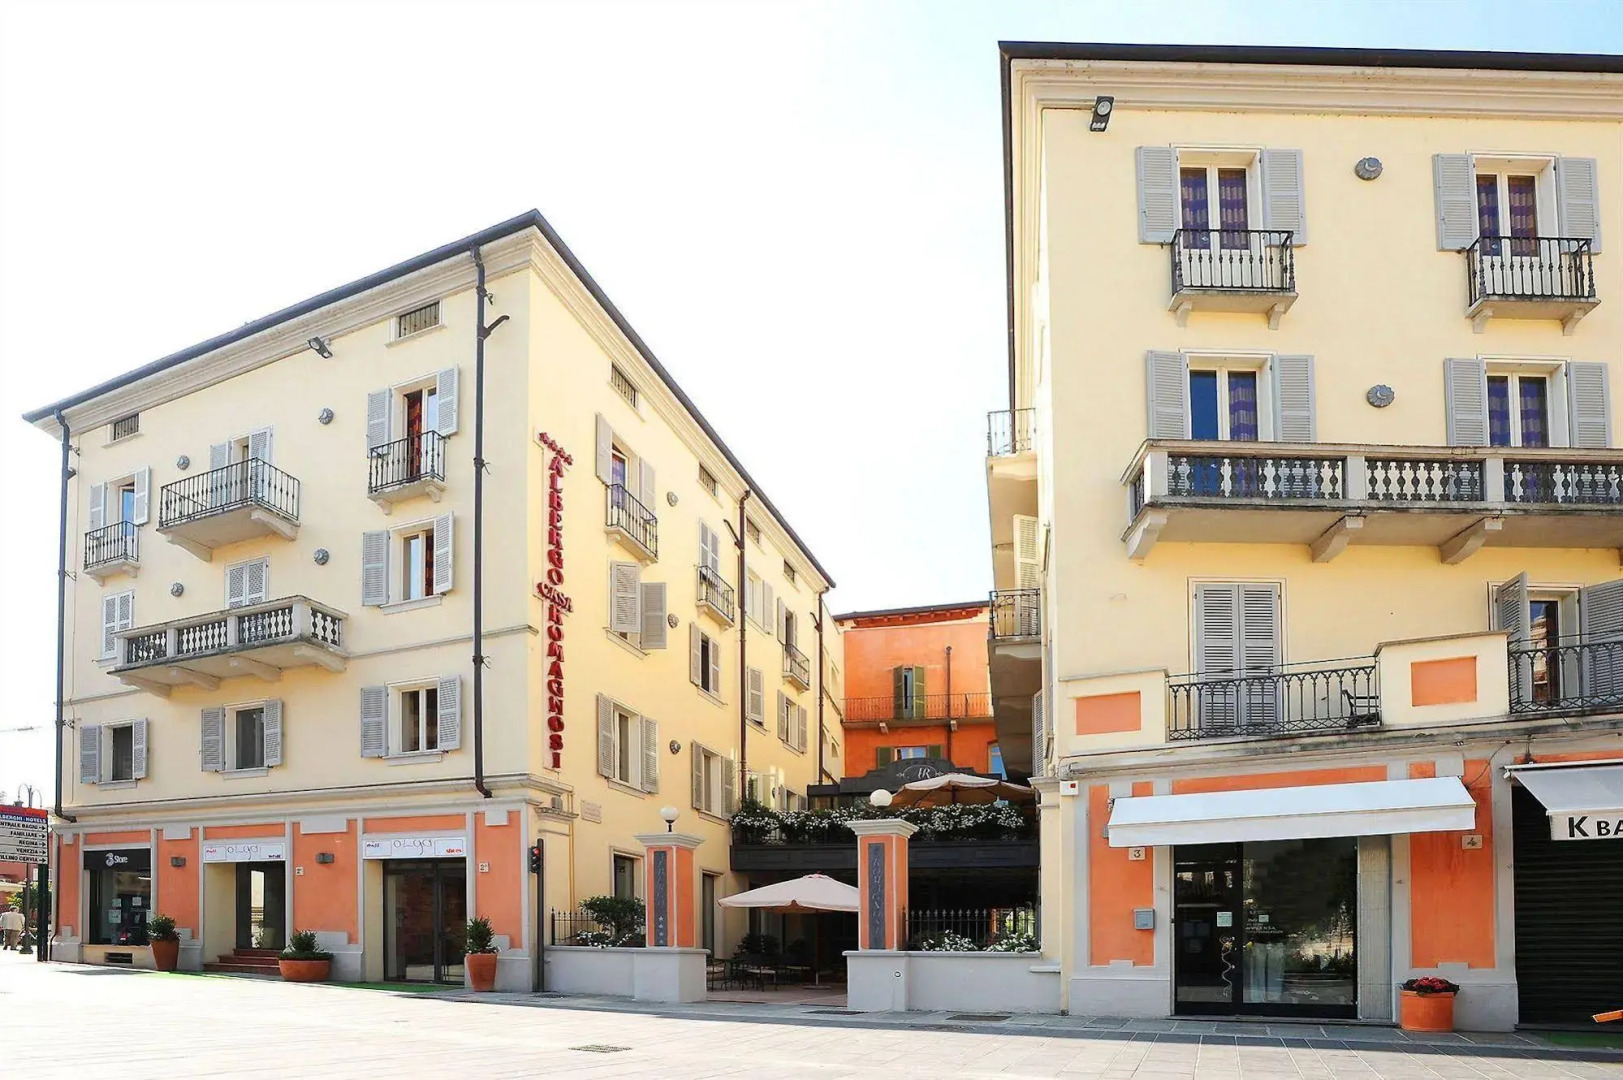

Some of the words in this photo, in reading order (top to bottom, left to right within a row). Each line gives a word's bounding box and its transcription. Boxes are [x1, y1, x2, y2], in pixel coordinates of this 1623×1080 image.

[1568, 816, 1590, 838] K
[1133, 849, 1141, 858] 3
[113, 855, 128, 864] Store
